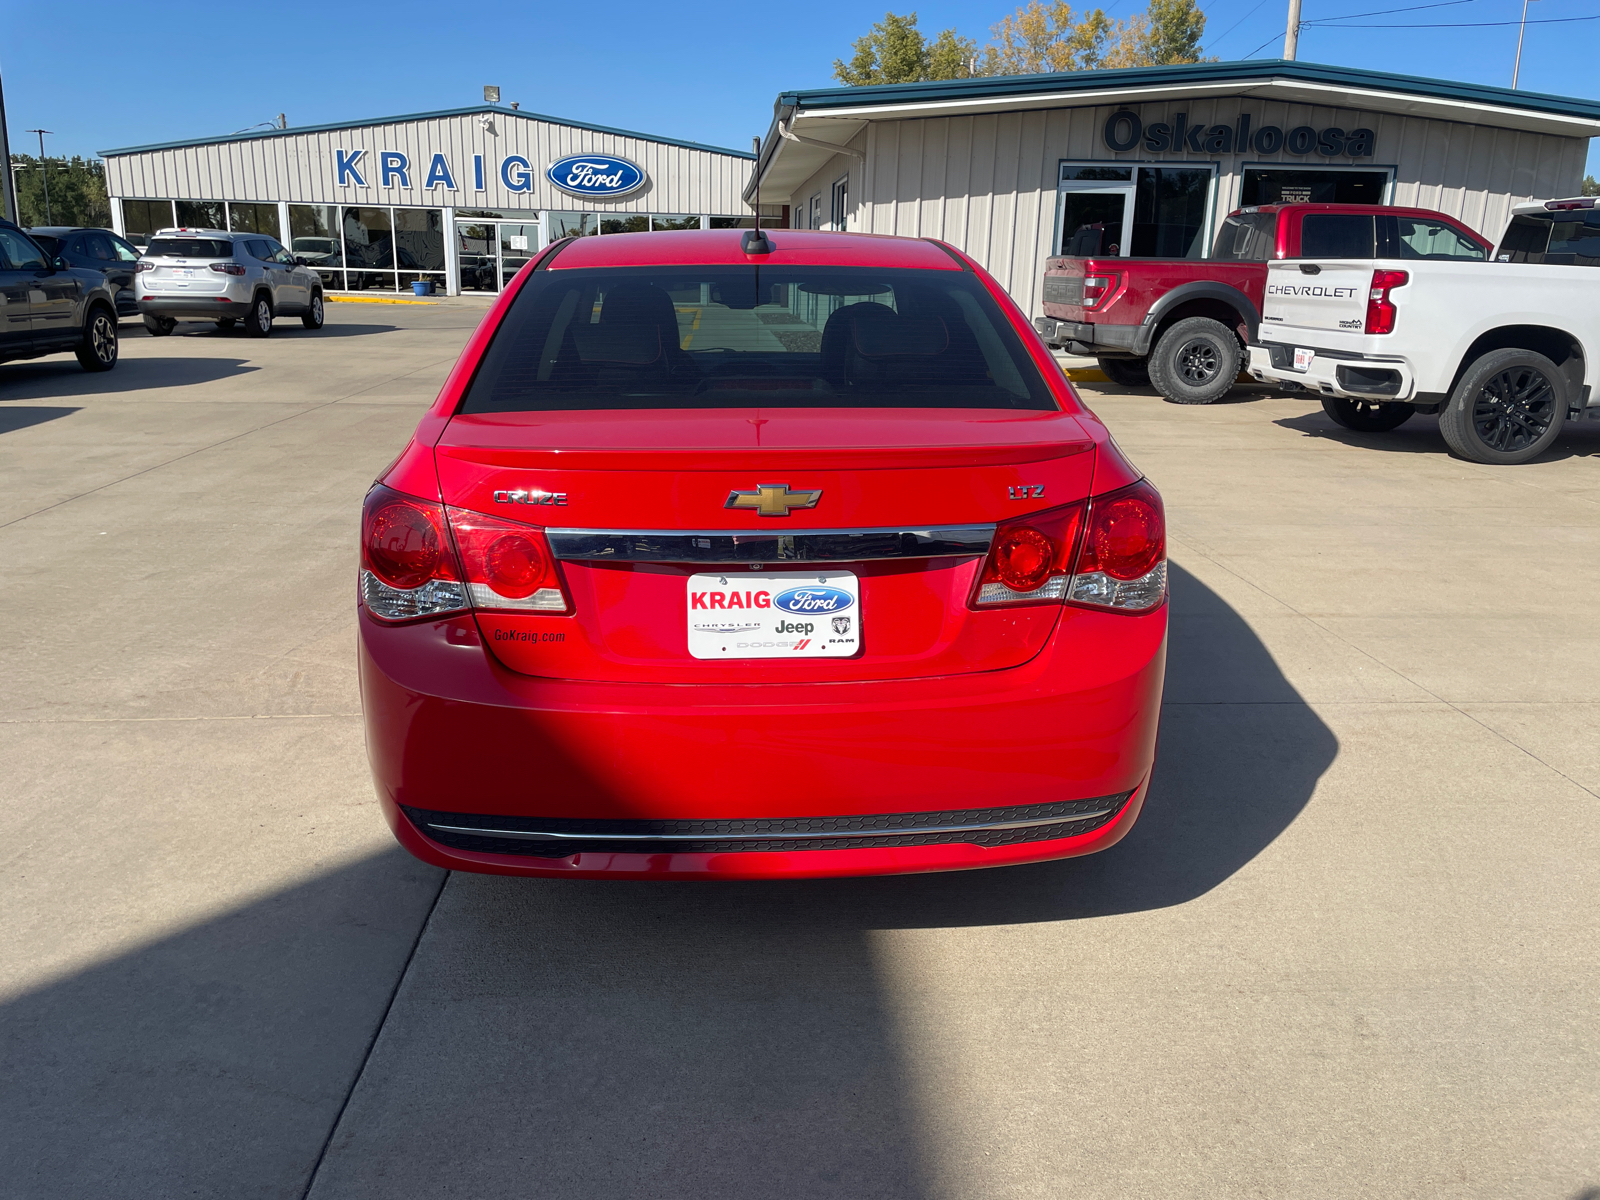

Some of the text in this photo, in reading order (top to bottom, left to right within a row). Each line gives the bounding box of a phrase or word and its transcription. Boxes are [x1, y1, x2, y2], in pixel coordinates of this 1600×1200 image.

[1104, 110, 1376, 157] Oskaloosa
[334, 148, 624, 194] KRAIG Ford
[1281, 195, 1310, 203] TRUCK
[1268, 285, 1358, 298] CHEVROLET
[494, 490, 568, 506] CRUZE
[1008, 484, 1045, 500] LTZ
[691, 591, 838, 610] KRAIG Ford
[775, 620, 814, 636] Jeep
[494, 629, 565, 644] GoKraig.com
